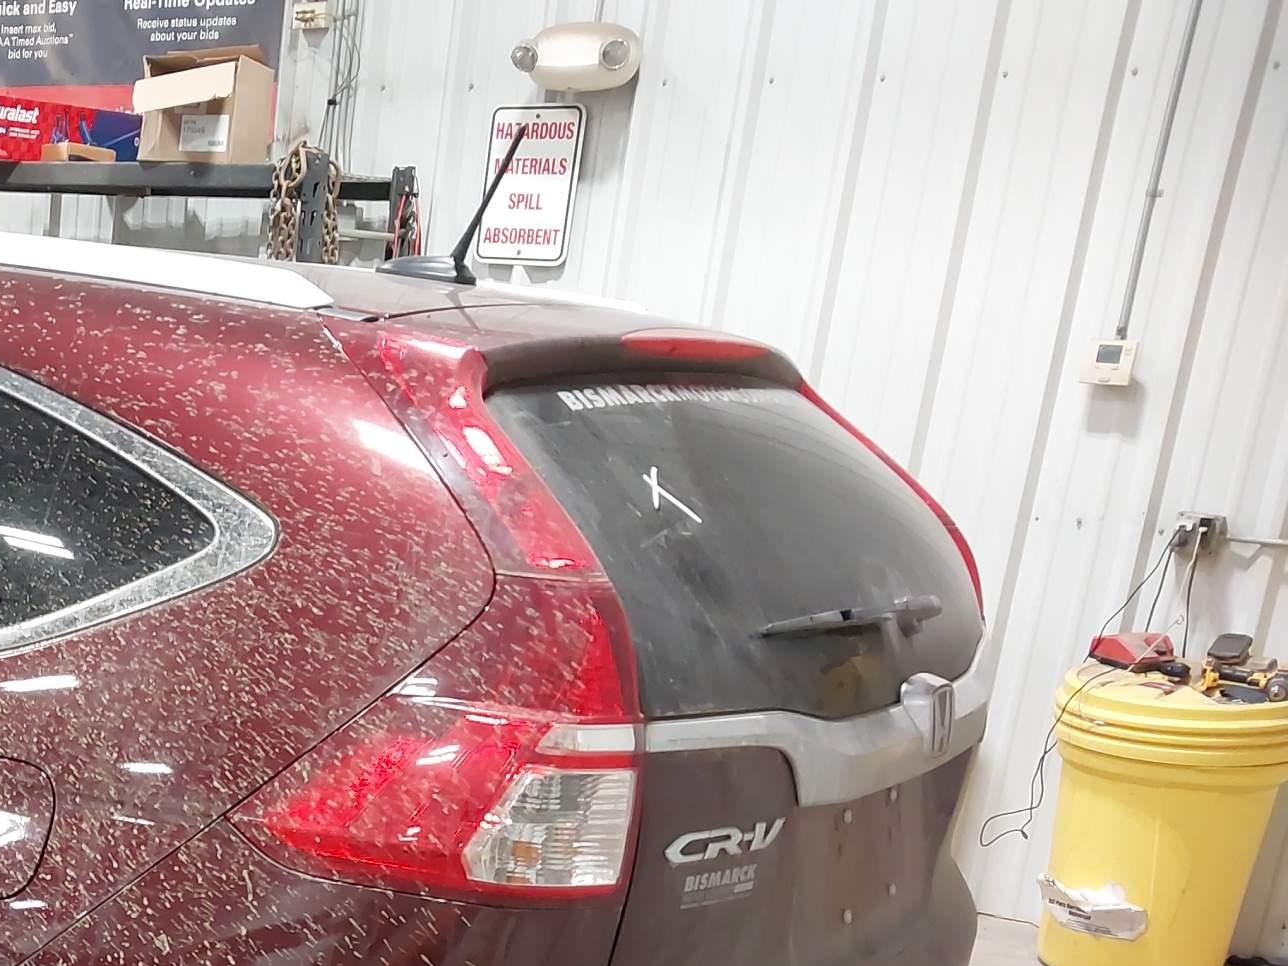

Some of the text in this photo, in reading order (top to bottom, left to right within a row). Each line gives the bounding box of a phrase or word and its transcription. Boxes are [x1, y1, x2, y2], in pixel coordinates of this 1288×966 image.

[23, 1, 46, 15] and
[49, 0, 77, 16] Easy
[1, 24, 24, 35] Insert
[43, 22, 57, 34] bid,
[171, 18, 197, 28] status
[200, 16, 237, 28] updates
[150, 28, 220, 42] about your bids
[7, 48, 48, 60] bid for you
[494, 157, 568, 176] MATERIALS
[507, 192, 543, 210] SPILL
[483, 226, 560, 246] ABSORBENT
[664, 816, 786, 864] CR-V
[684, 863, 758, 892] BISMARCK
